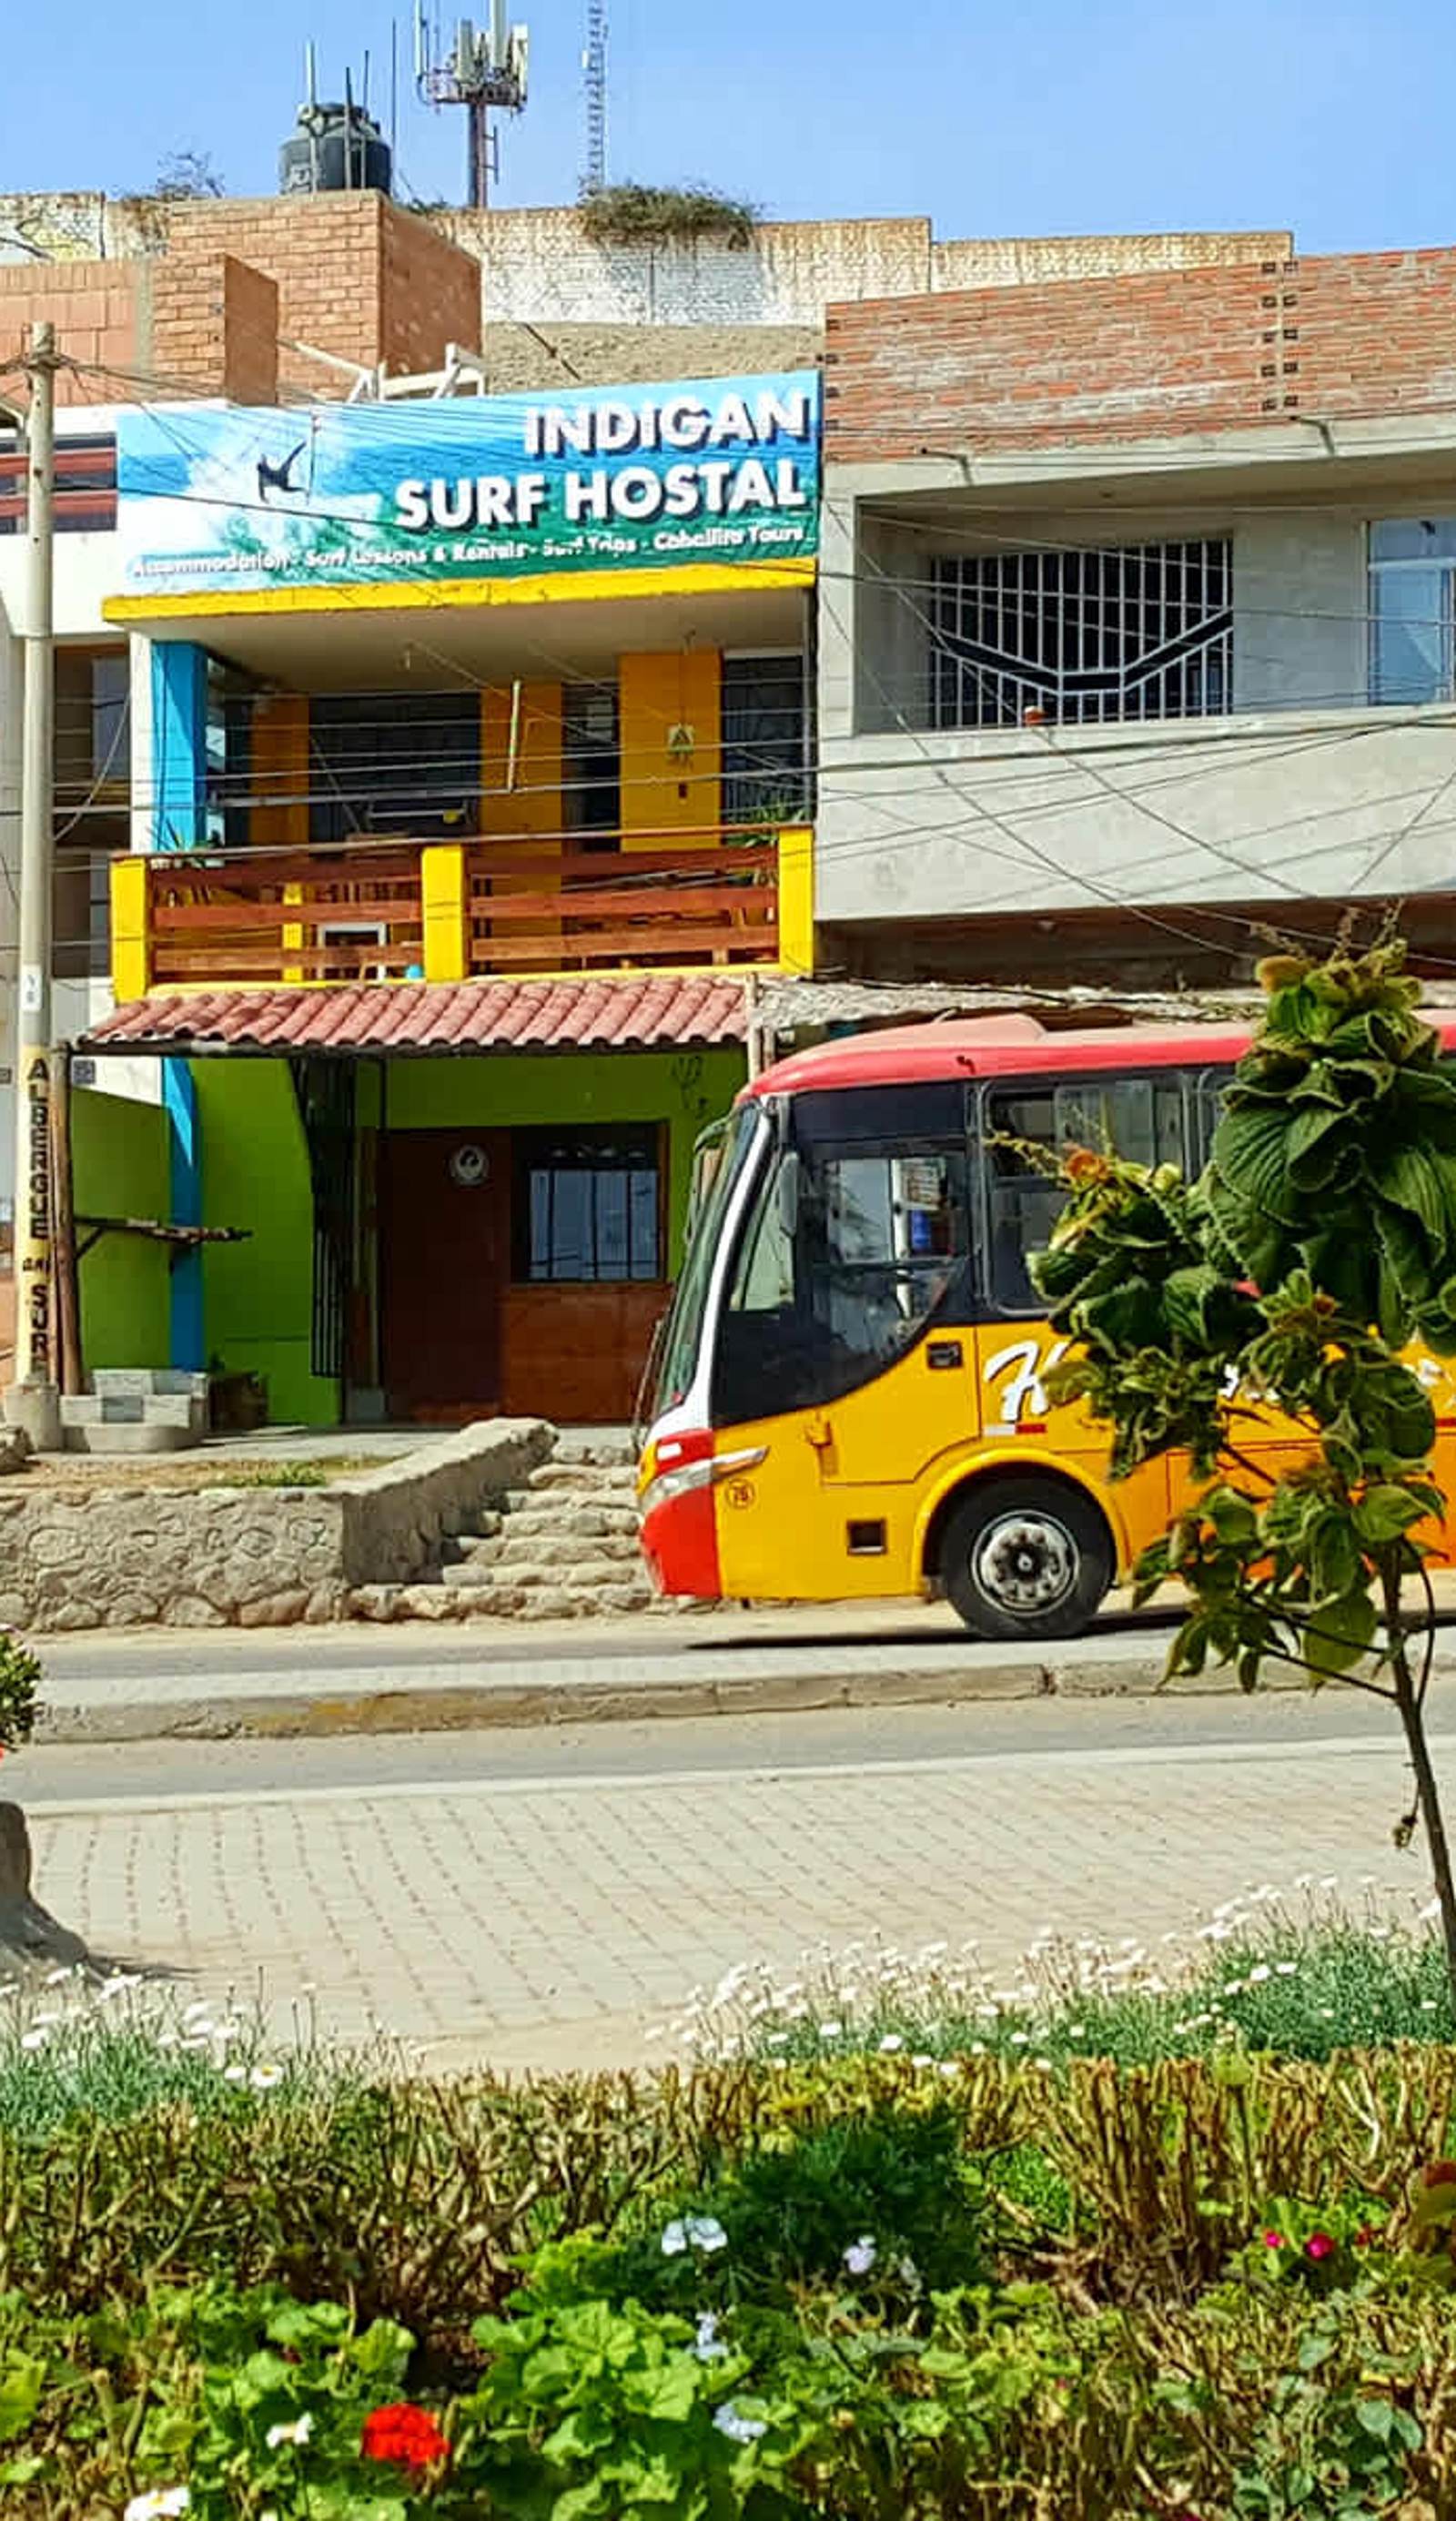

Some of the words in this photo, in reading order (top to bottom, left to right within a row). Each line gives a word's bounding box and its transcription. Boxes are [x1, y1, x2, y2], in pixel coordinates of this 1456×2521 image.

[524, 390, 807, 456] INDIGAN
[394, 475, 548, 531] SURF
[563, 458, 807, 521] HOSTAL
